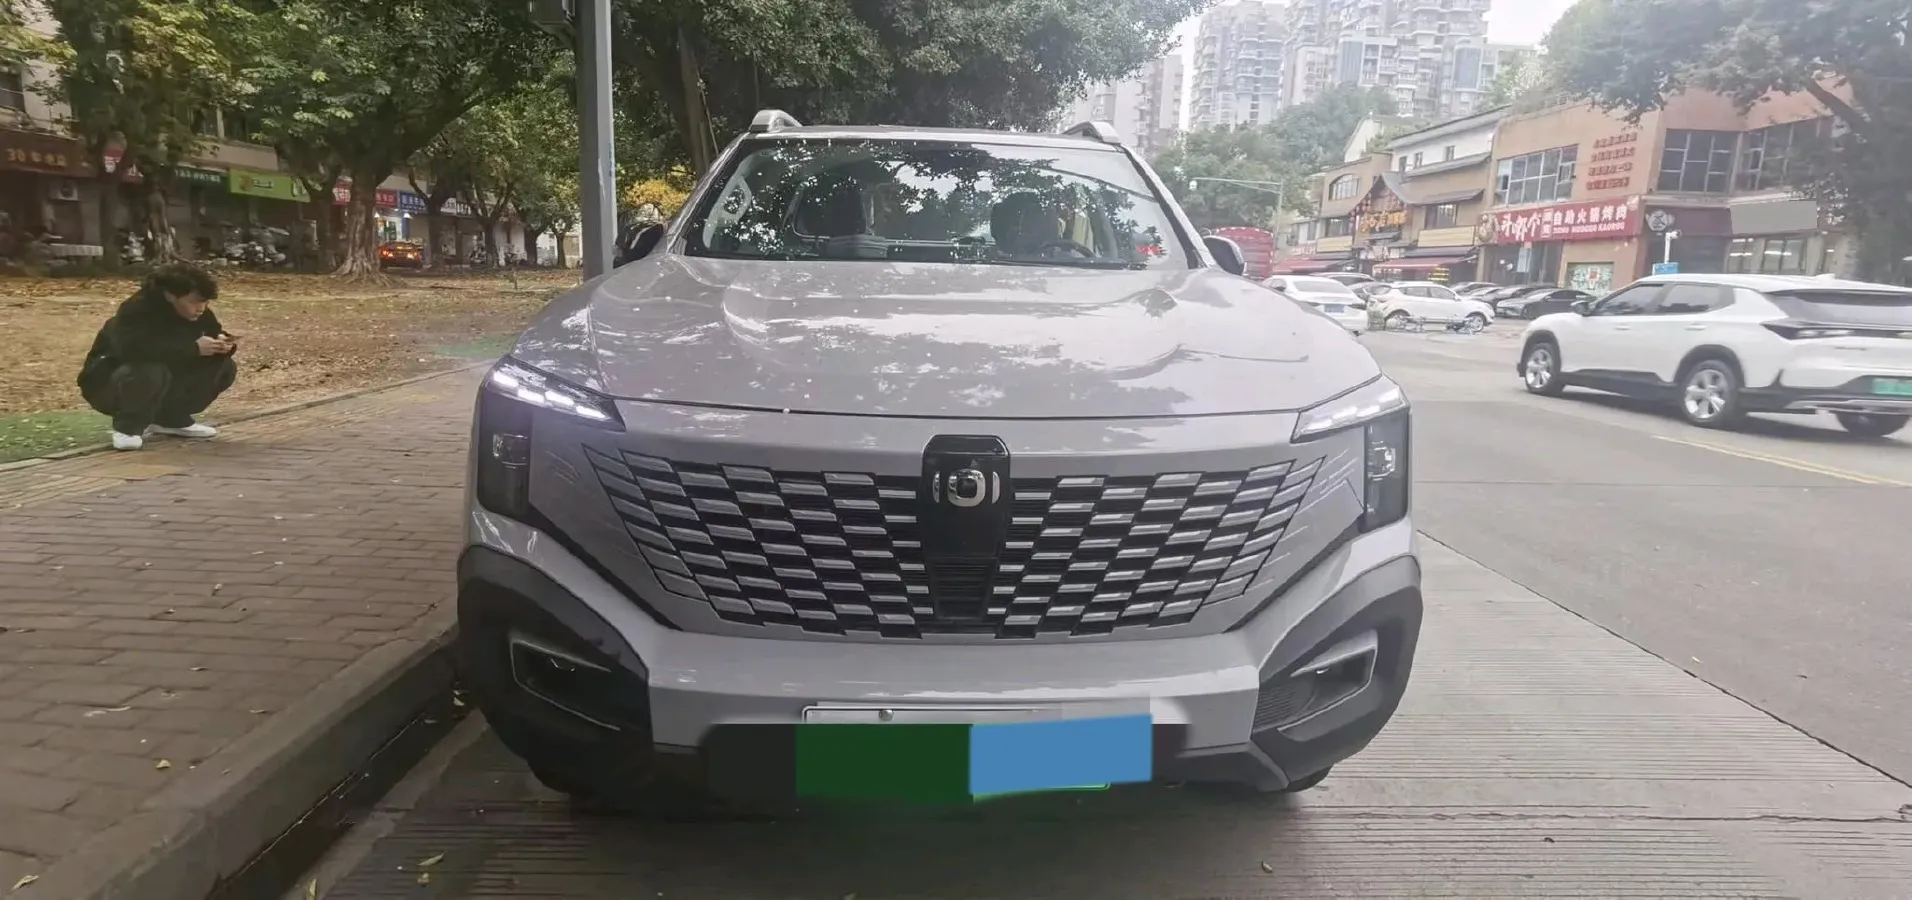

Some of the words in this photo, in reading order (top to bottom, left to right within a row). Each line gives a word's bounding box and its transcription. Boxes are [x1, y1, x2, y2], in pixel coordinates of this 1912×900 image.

[1554, 205, 1627, 225] 自助火锅烤肉
